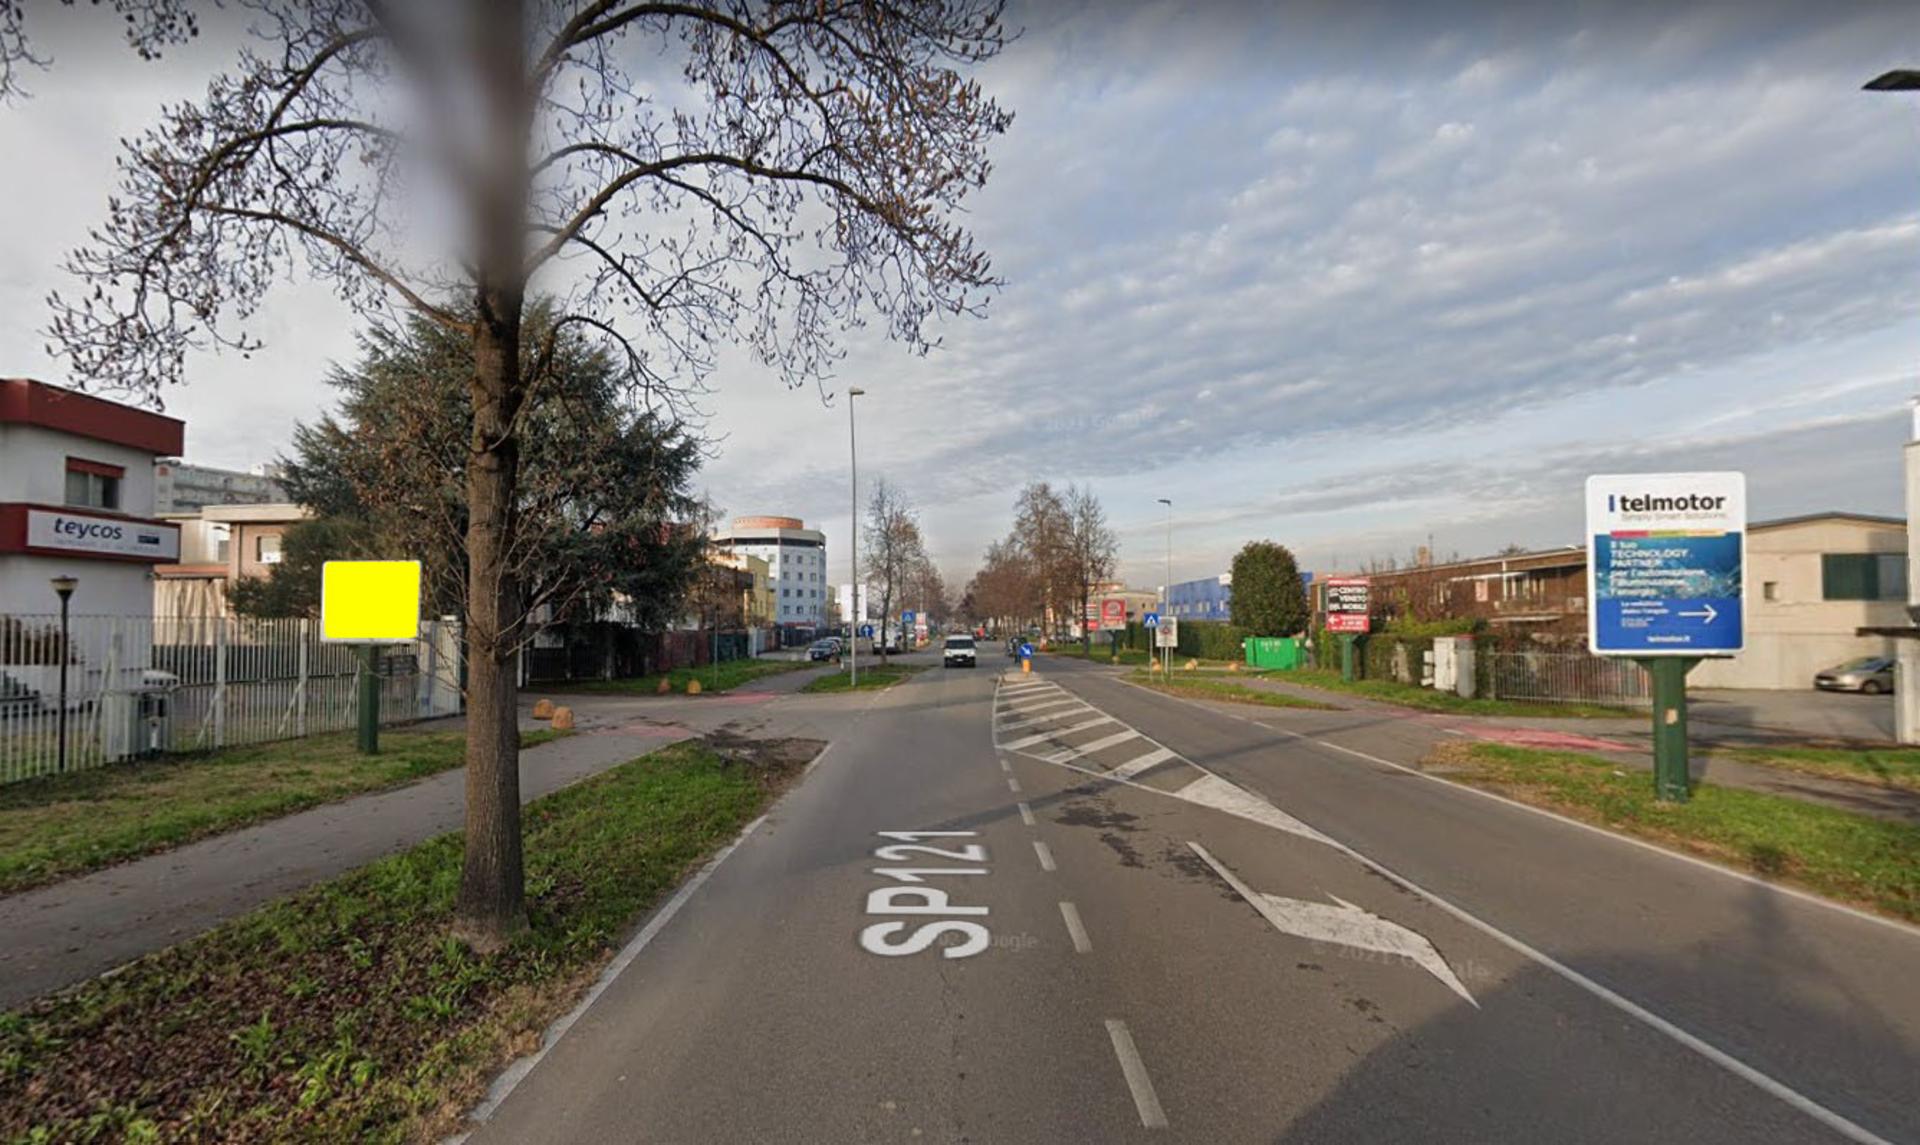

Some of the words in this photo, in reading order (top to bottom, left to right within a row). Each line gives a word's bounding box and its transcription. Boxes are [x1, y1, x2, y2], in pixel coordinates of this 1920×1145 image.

[1621, 494, 1725, 512] telmotor
[54, 518, 122, 540] teycos
[1610, 548, 1689, 559] TECHNOLOGY
[1610, 558, 1662, 568] PARTNER
